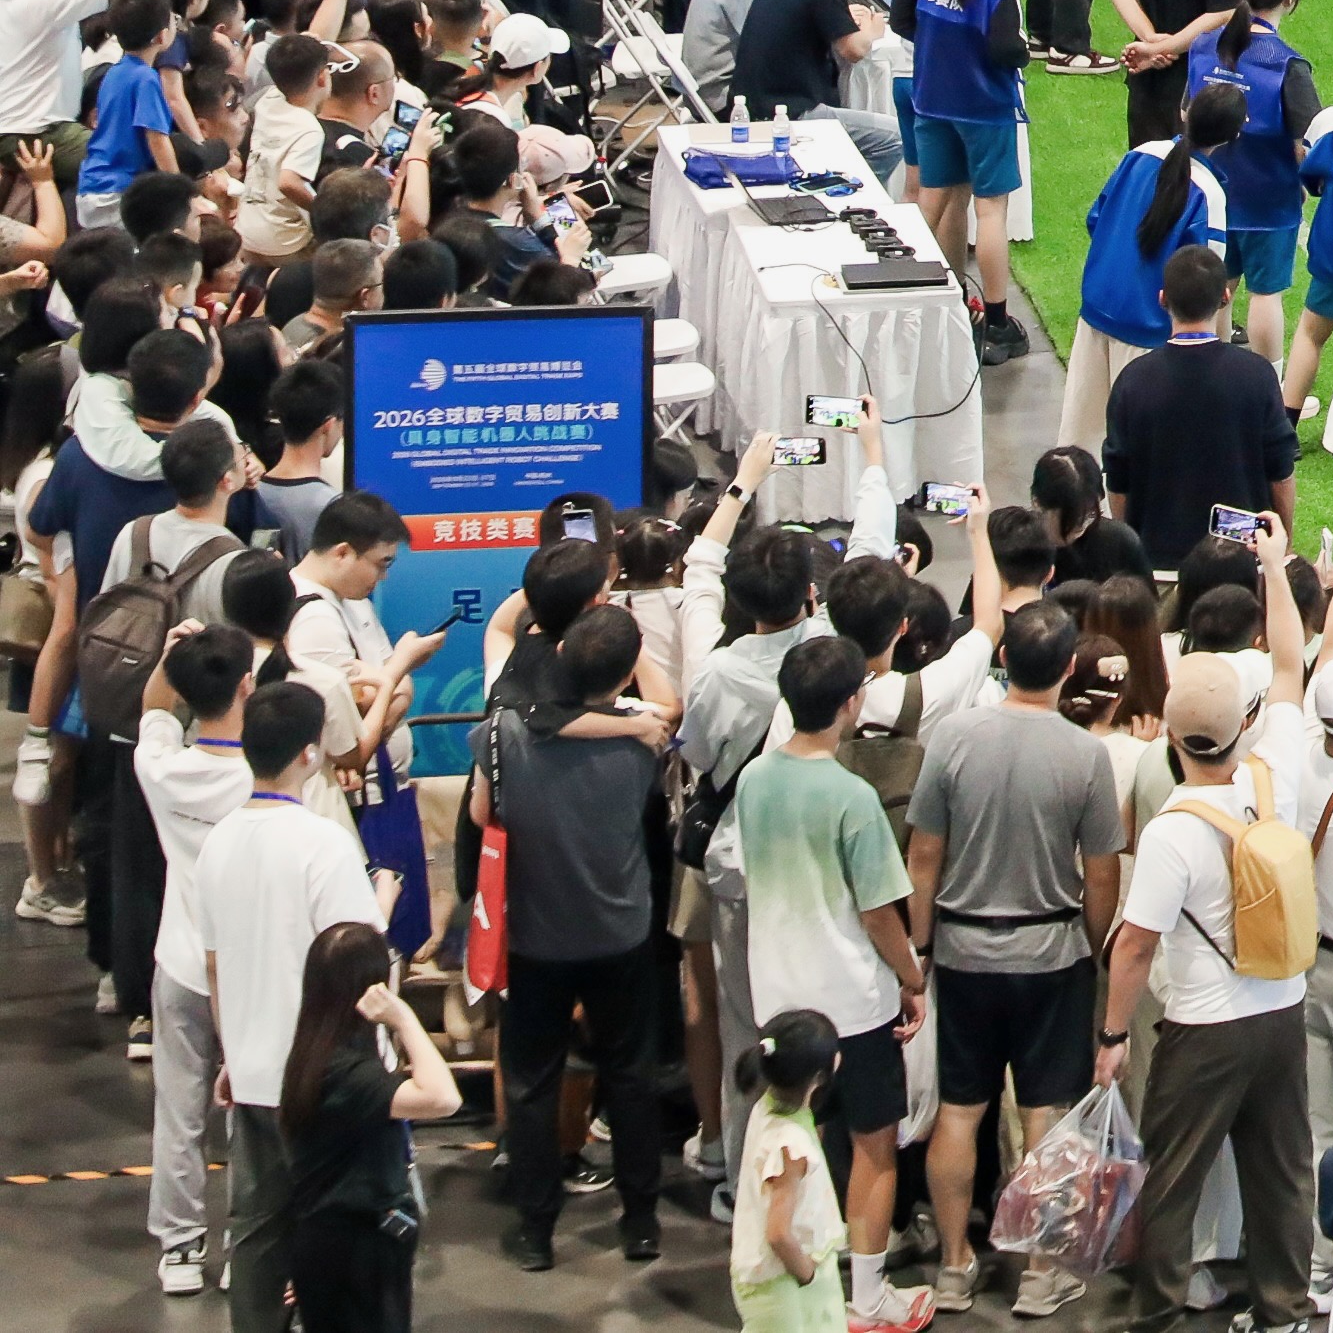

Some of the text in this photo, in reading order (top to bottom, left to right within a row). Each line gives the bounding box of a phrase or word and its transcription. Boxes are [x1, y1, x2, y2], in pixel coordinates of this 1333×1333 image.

[373, 402, 619, 429] 2026全球数字贸易创新大赛
[432, 517, 536, 543] 竞技类赛
